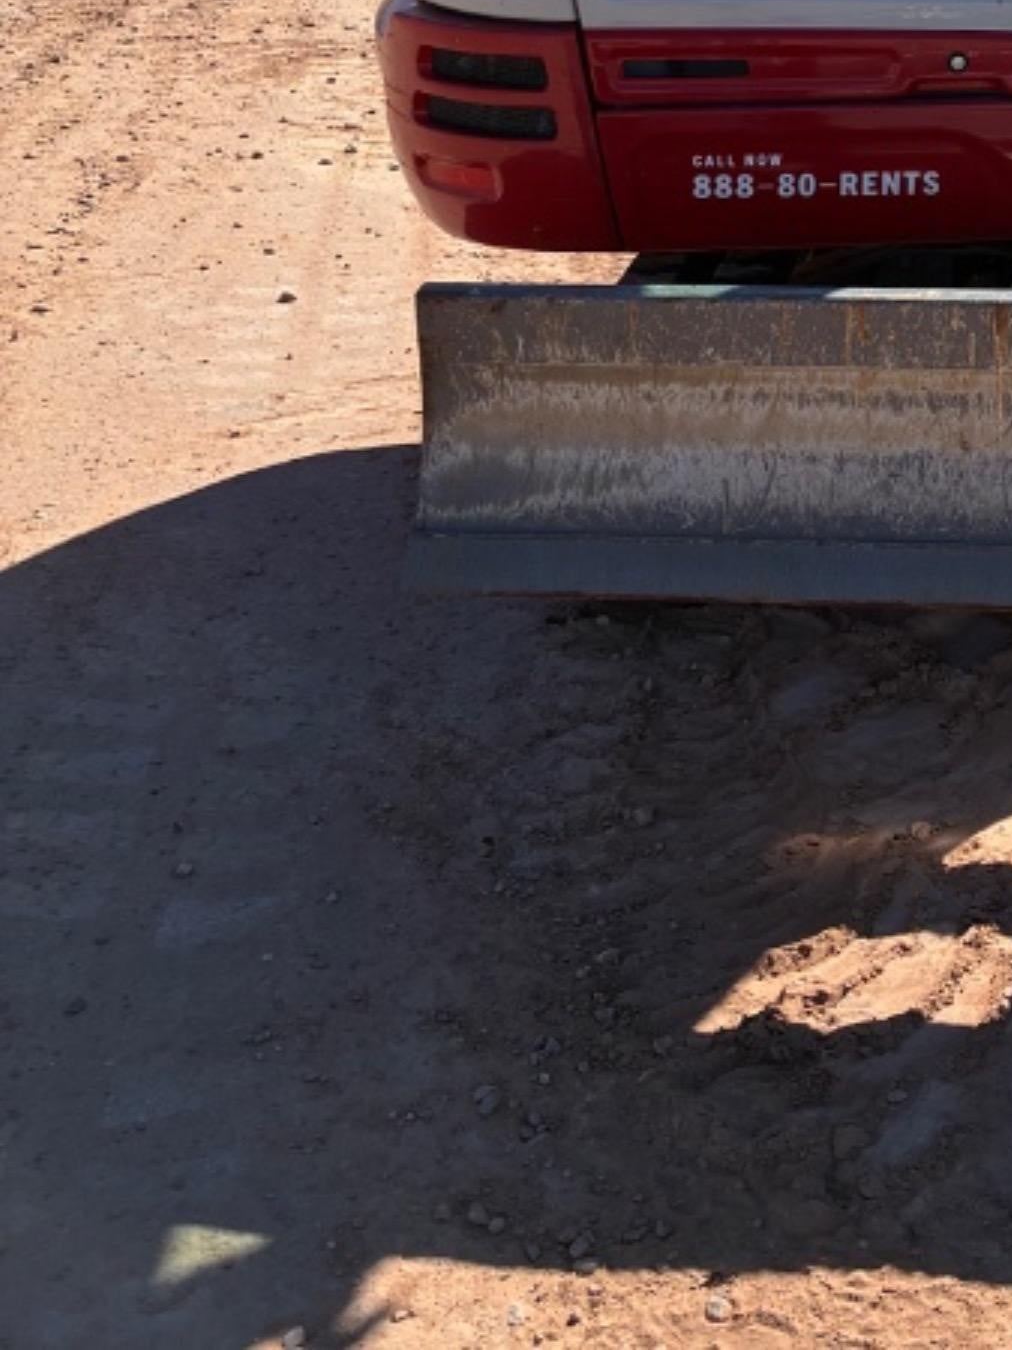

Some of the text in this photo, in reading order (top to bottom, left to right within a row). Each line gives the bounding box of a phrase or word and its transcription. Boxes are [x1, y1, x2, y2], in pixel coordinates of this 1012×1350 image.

[692, 153, 783, 168] CALL NOW
[693, 170, 941, 199] 888-80-RENTS
